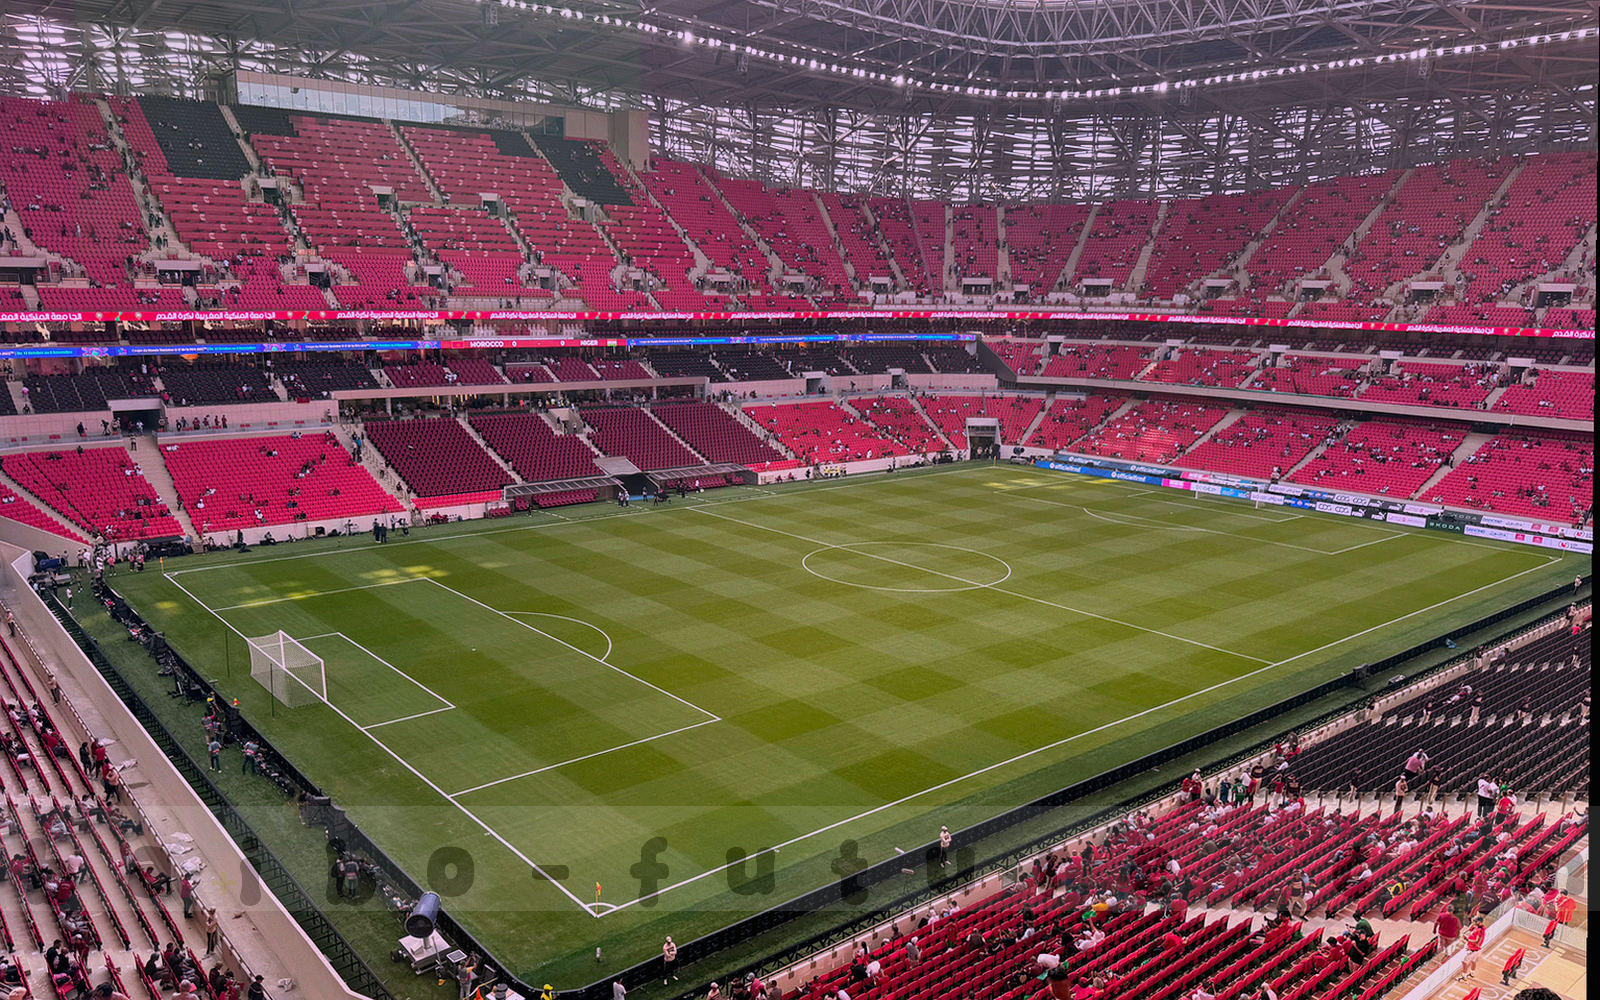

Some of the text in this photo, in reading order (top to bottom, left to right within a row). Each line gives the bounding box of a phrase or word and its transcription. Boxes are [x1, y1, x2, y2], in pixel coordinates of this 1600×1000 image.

[470, 340, 504, 348] MOROCCO
[511, 340, 517, 348] 0
[580, 339, 599, 347] NIGER
